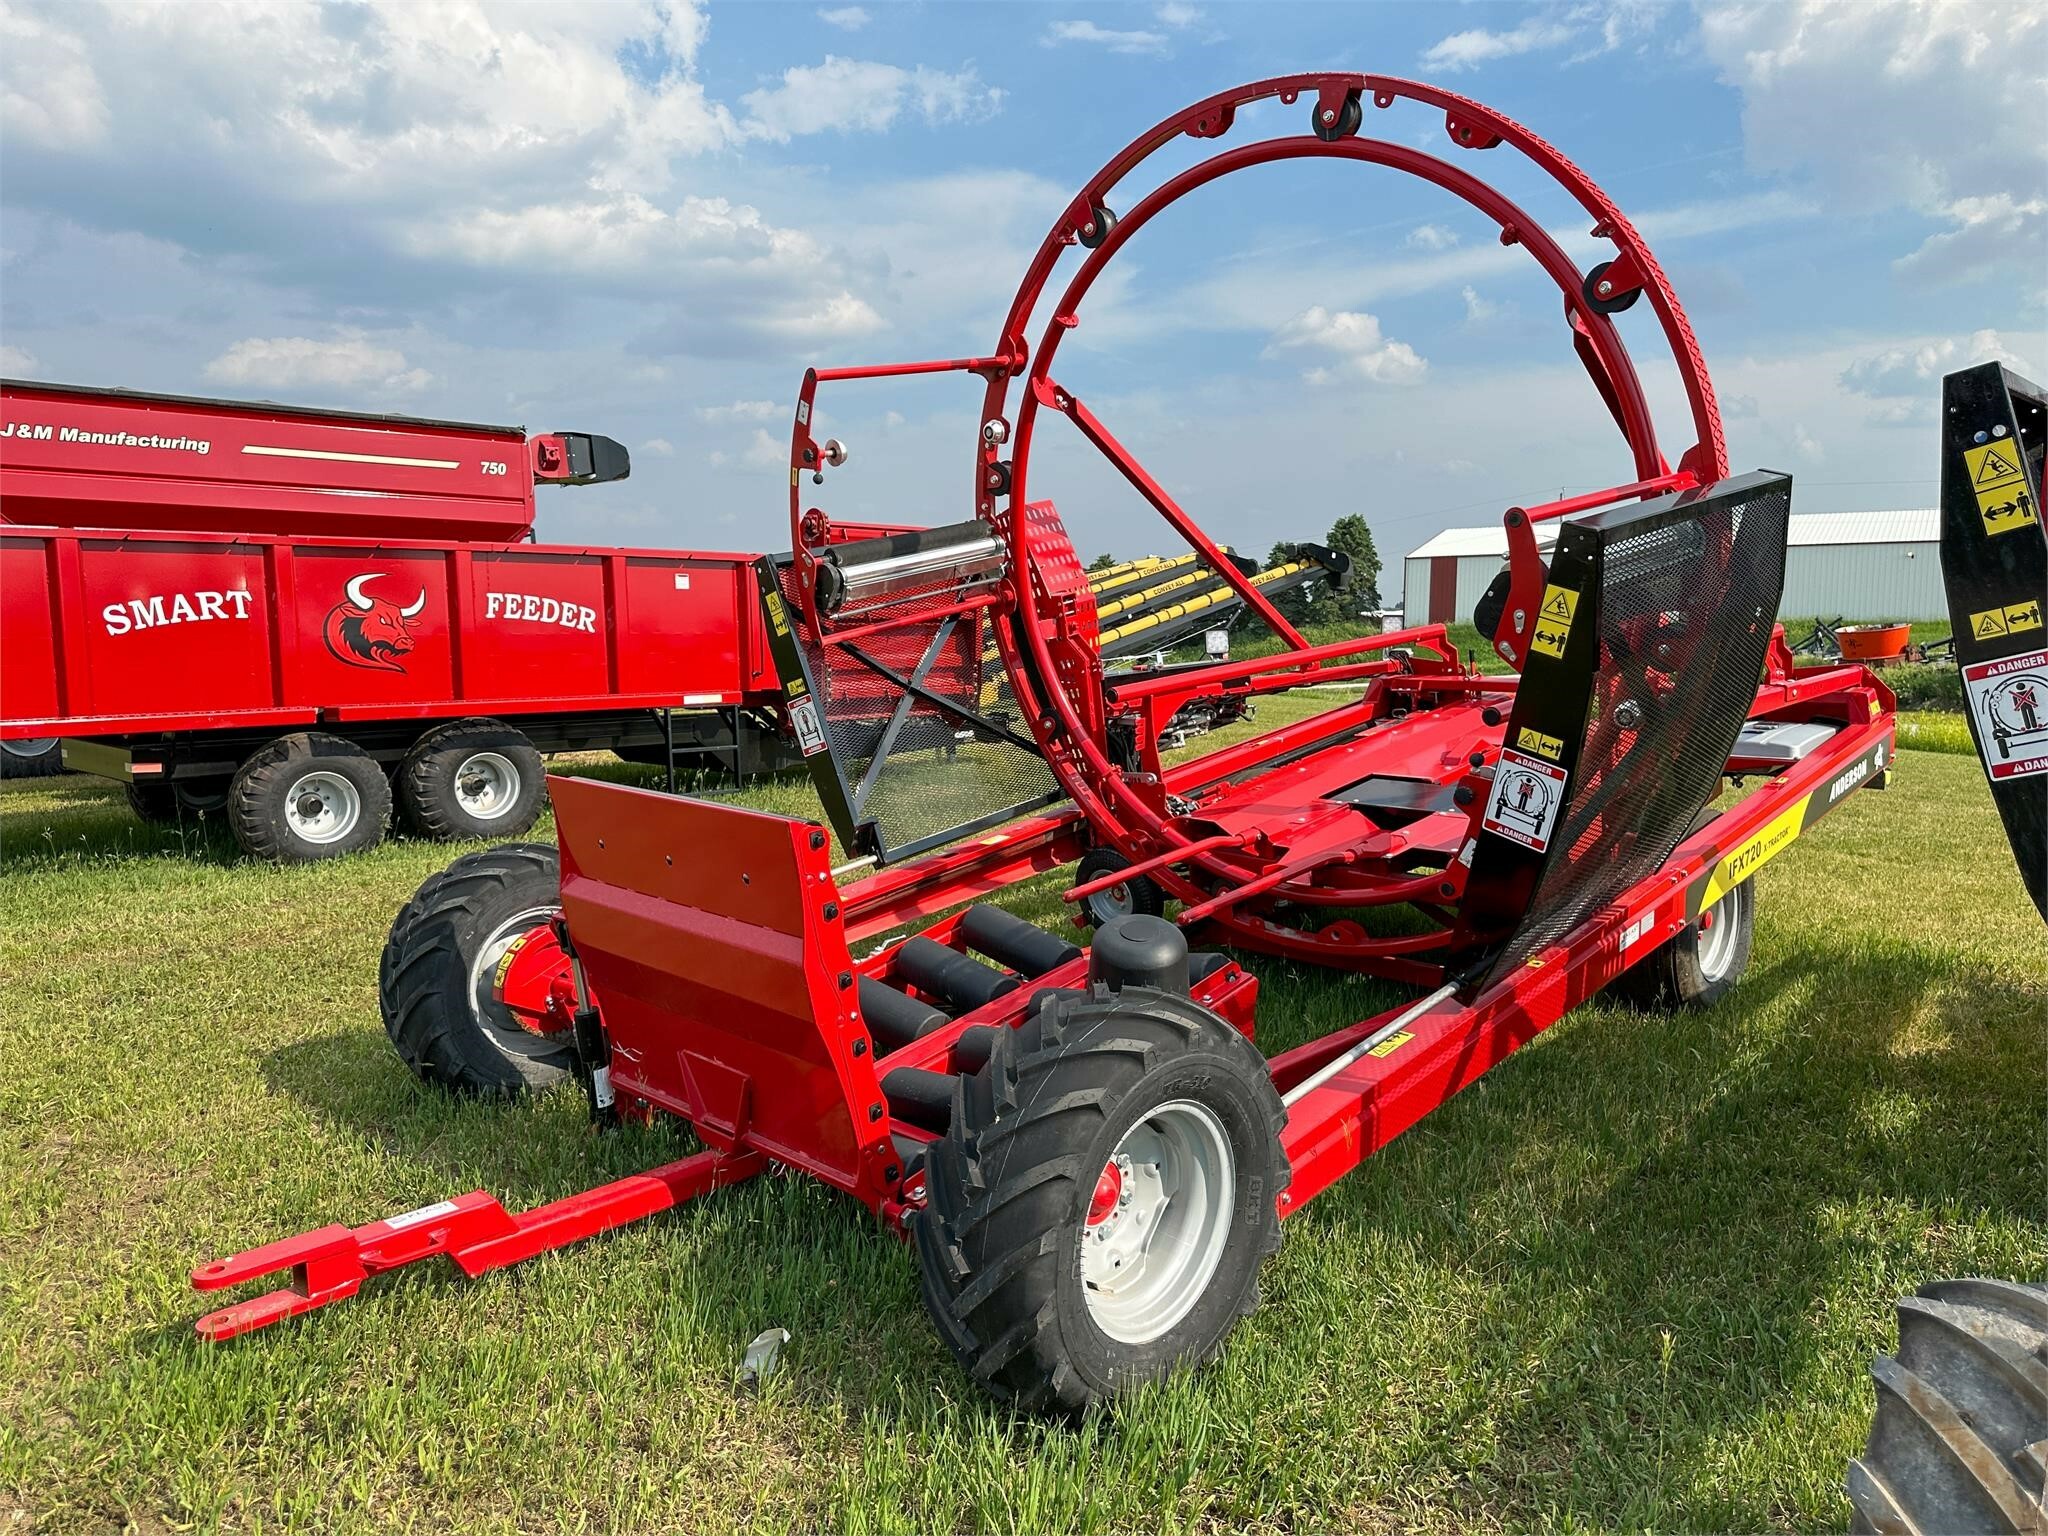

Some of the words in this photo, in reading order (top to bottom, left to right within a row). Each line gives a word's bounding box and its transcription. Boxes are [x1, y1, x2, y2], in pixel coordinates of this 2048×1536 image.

[0, 422, 53, 441] J&M
[59, 426, 212, 455] Manufacturing
[480, 461, 507, 476] 750
[102, 590, 253, 636] SMART
[485, 592, 597, 634] FEEDER
[1997, 655, 2046, 674] DANGER
[1522, 759, 1553, 776] DANGER
[2024, 758, 2048, 771] DAN
[1828, 758, 1868, 803] ANDERSON
[1503, 828, 1533, 845] DANGER
[1728, 840, 1762, 880] IFX720
